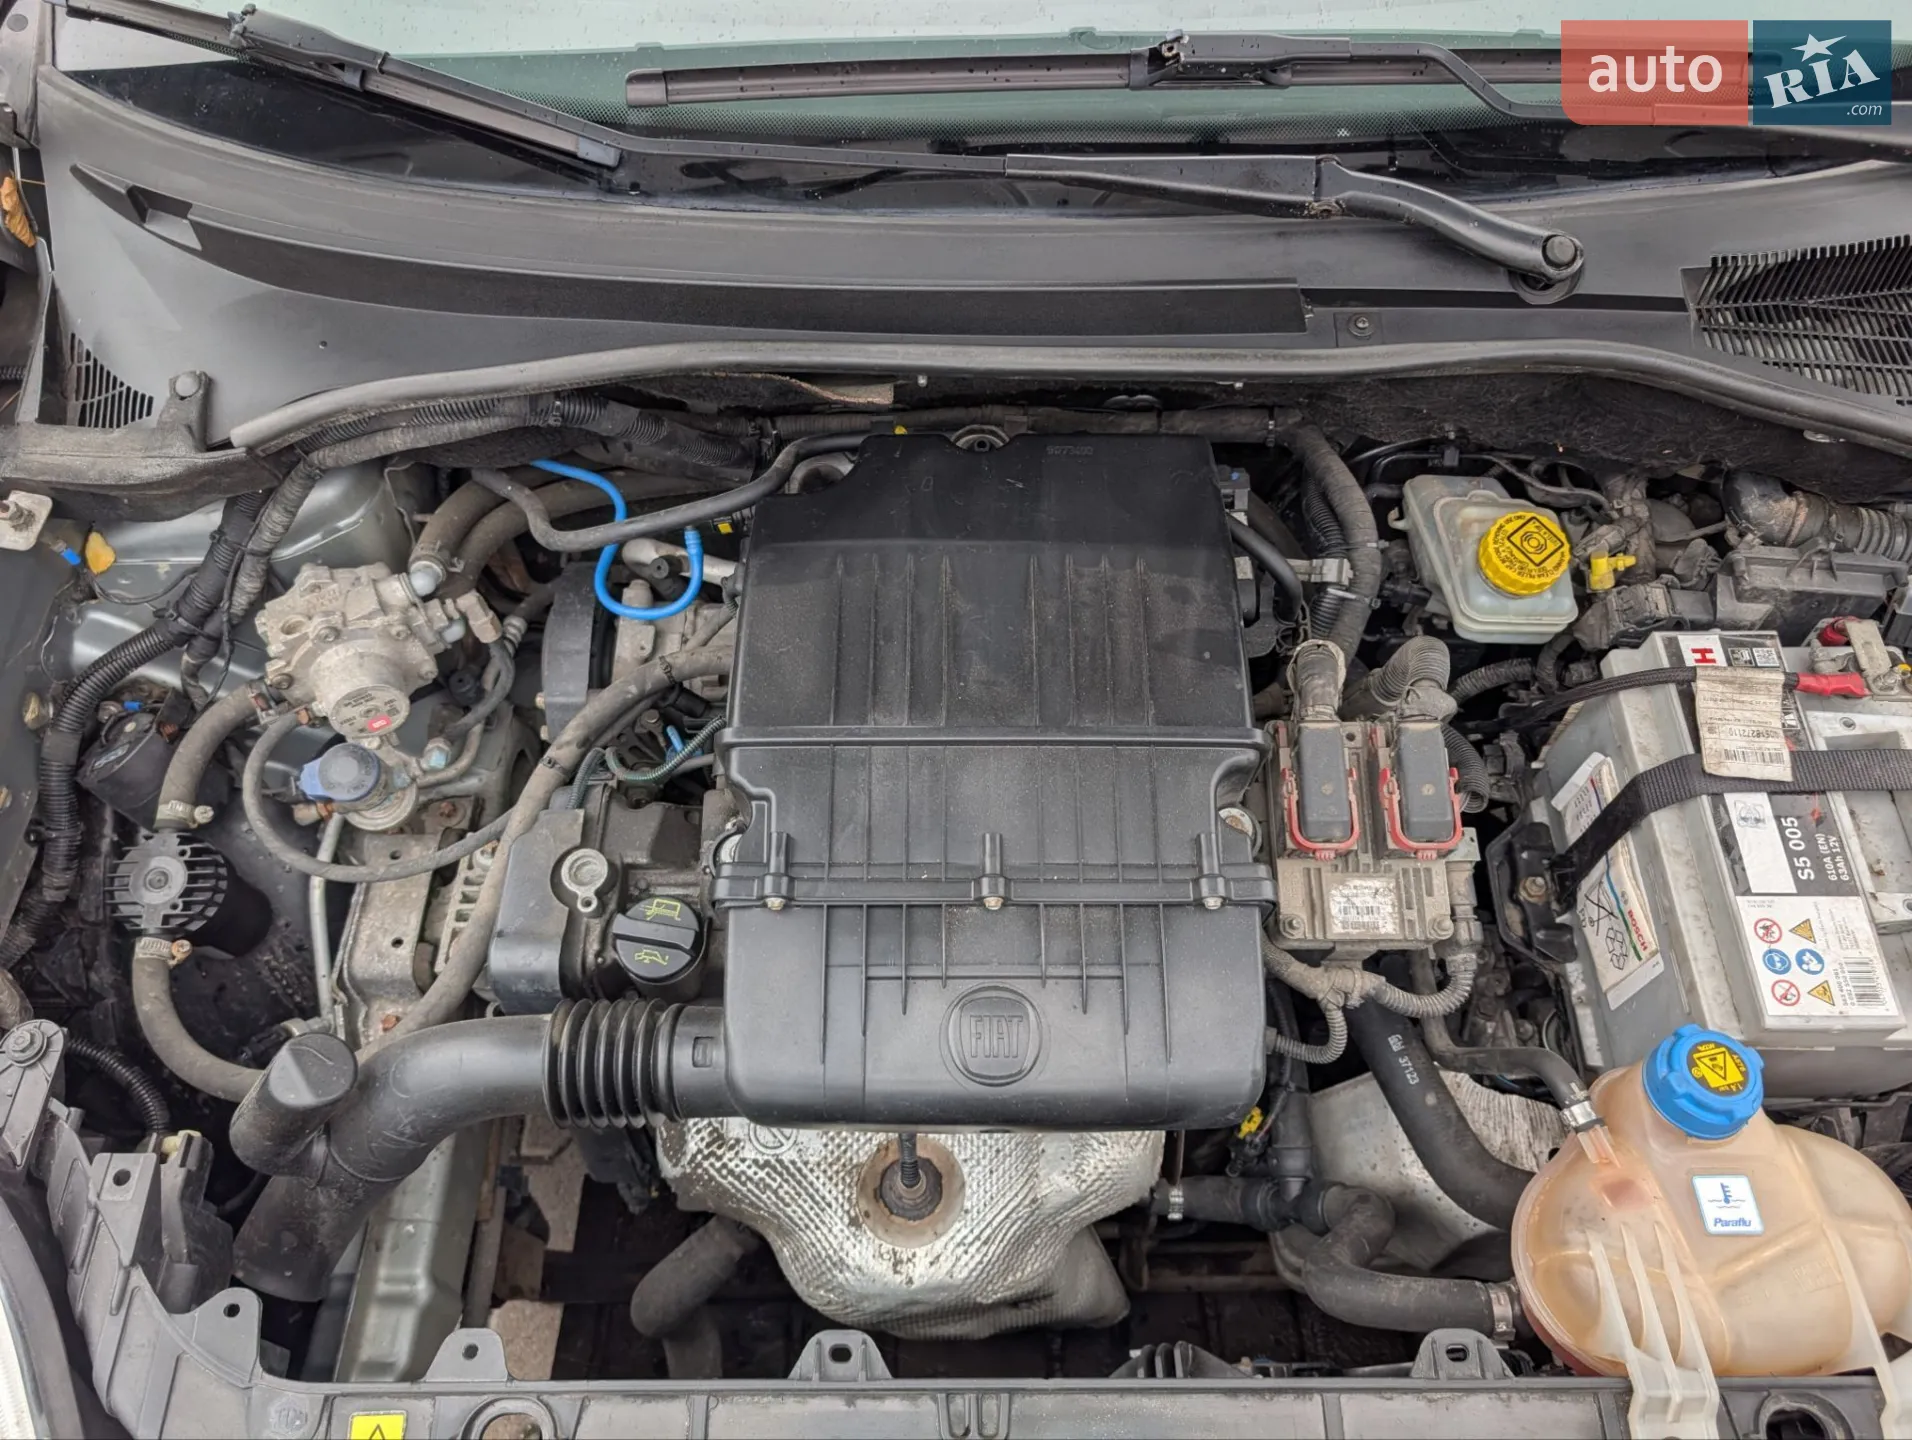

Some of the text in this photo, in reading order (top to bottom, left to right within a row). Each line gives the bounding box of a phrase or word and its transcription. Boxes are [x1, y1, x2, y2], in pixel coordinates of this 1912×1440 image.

[1781, 817, 1815, 880] S5 005
[1815, 833, 1838, 880] 610A (EN)
[1827, 835, 1850, 880] 63Ah 12V
[1627, 909, 1648, 951] BOSCH
[970, 1014, 1024, 1059] FIAT
[1398, 1055, 1420, 1085] 37123
[1713, 1217, 1752, 1228] Paraflu
